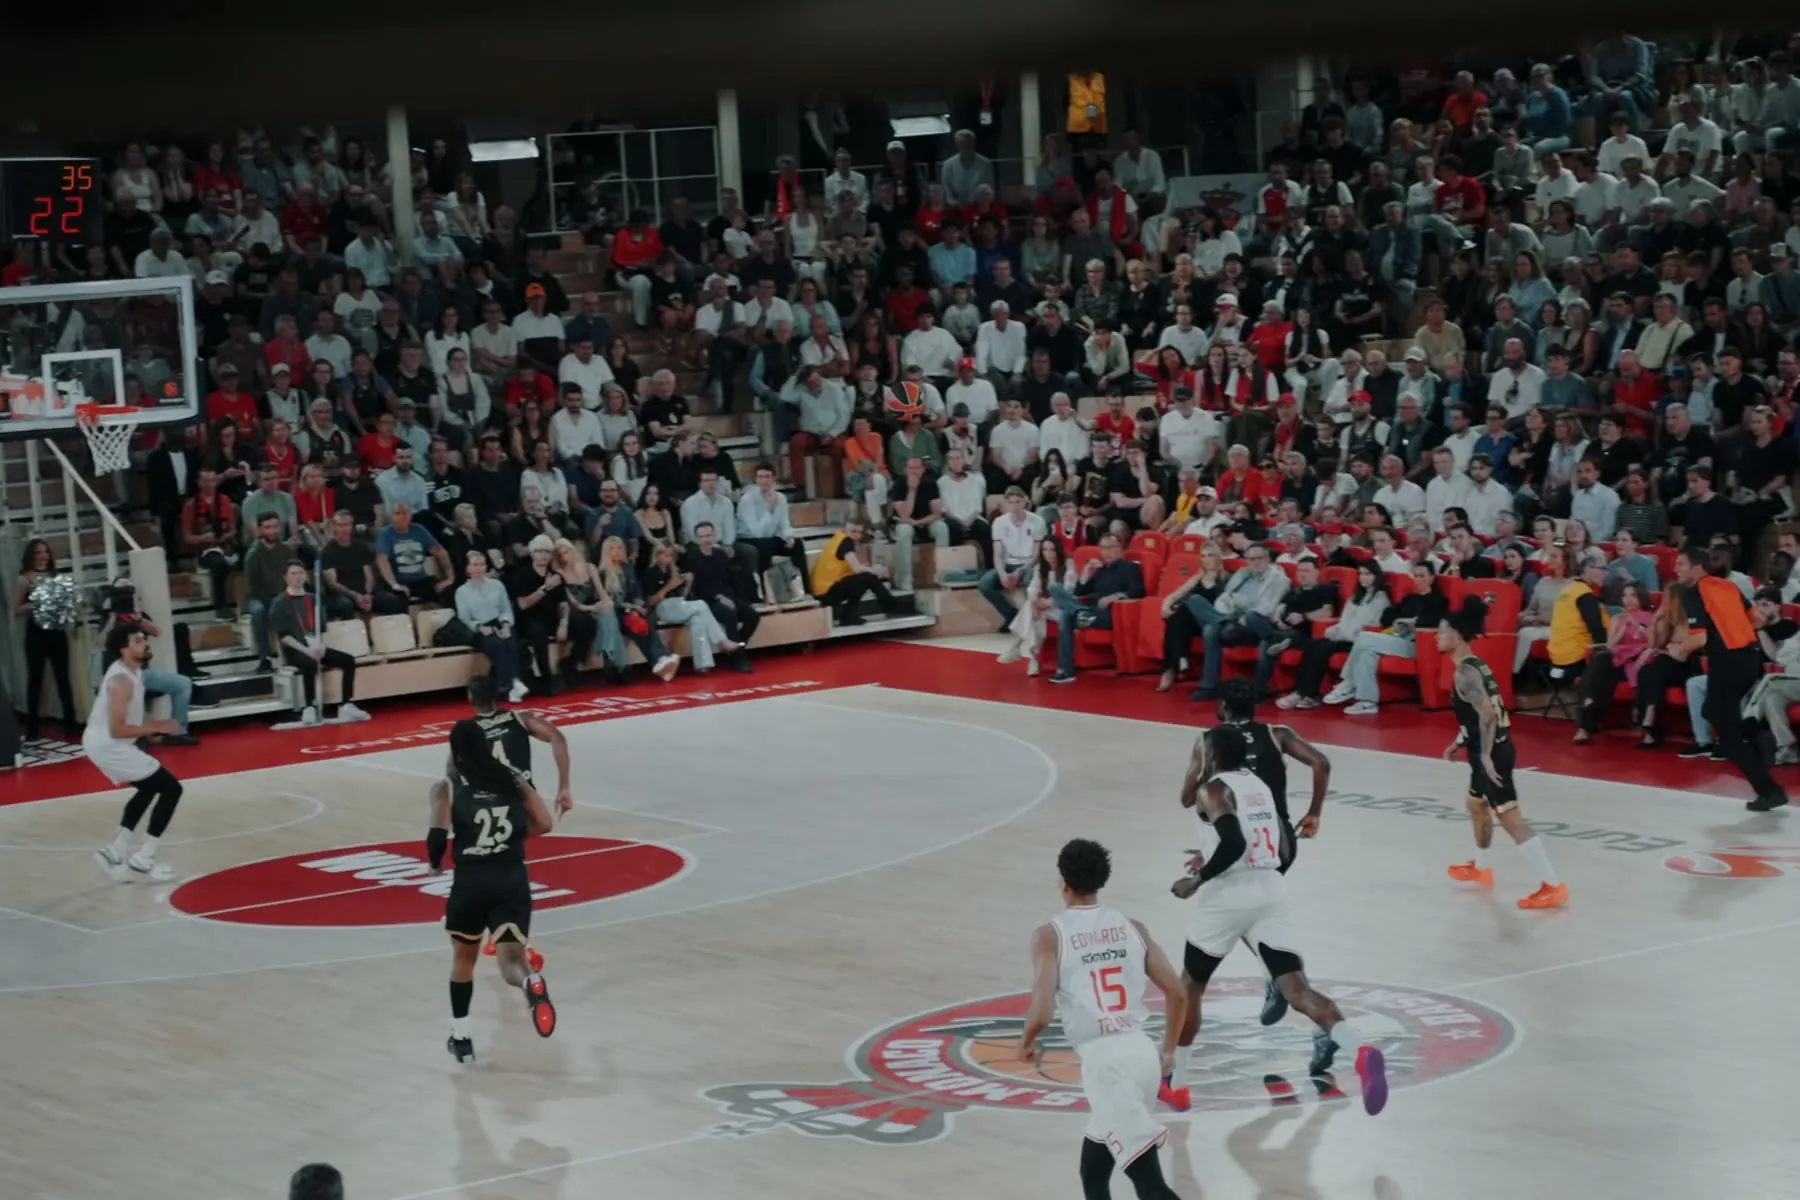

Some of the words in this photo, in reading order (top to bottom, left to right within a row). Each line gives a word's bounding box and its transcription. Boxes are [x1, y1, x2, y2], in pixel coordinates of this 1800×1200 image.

[61, 165, 92, 191] 35
[29, 196, 84, 235] 22
[473, 805, 514, 847] 23
[1288, 790, 1686, 853] Euroeague
[1247, 826, 1276, 864] 21
[1070, 926, 1128, 951] EDWARDS
[1089, 965, 1128, 1013] 15
